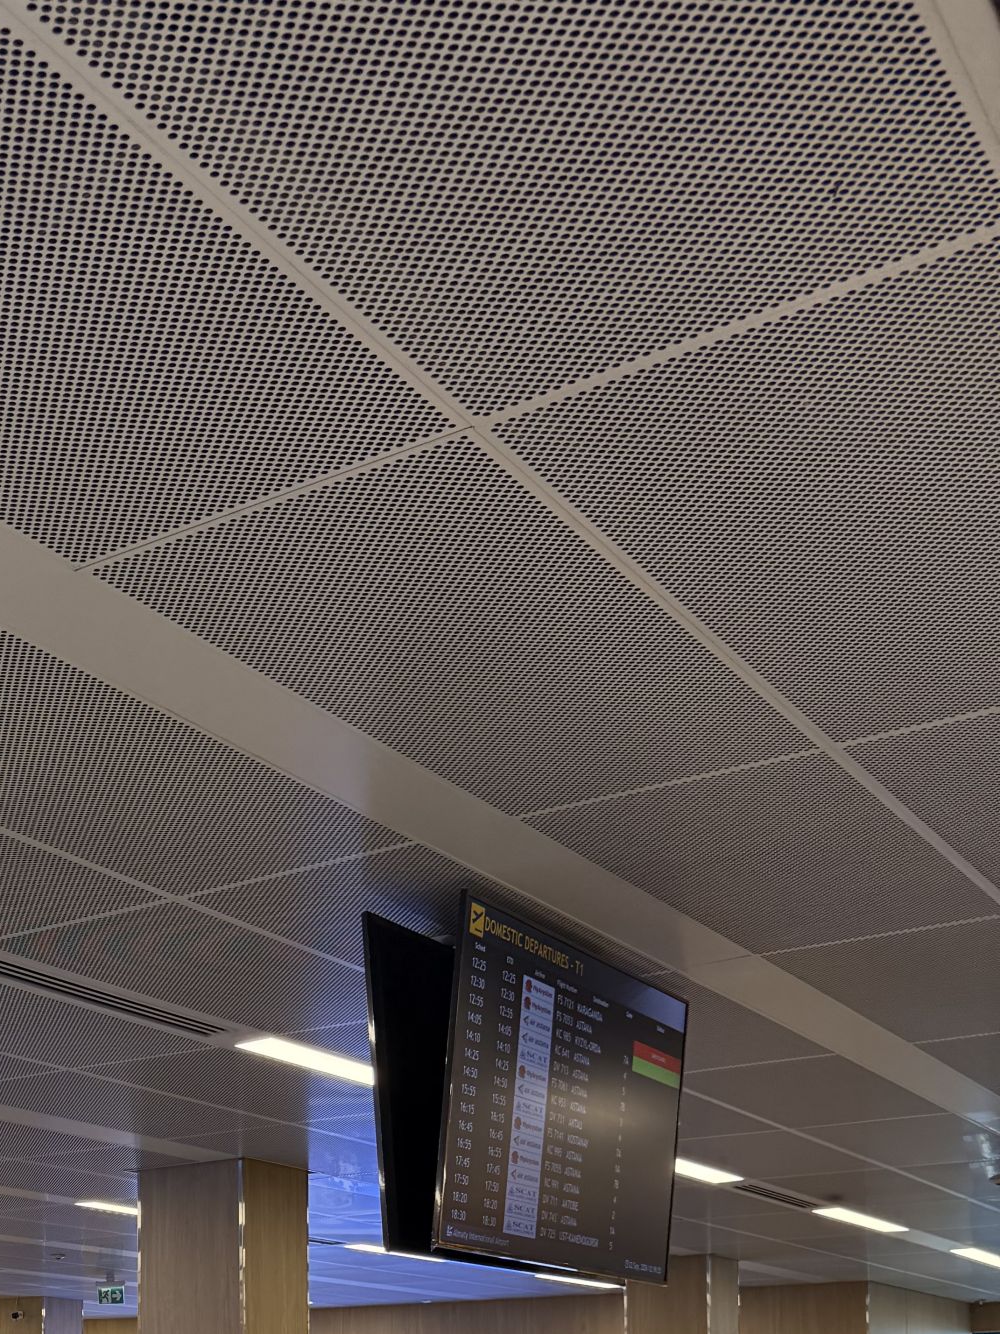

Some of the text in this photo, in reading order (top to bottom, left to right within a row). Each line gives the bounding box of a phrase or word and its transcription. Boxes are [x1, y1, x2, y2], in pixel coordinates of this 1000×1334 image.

[485, 917, 523, 948] DOMESTIC
[524, 935, 569, 969] DEPARTURES
[575, 960, 584, 977] T1
[471, 955, 486, 972] 12:25
[470, 973, 485, 990] 12:30
[501, 968, 516, 985] 12:25
[468, 992, 483, 1008] 12:55
[500, 986, 514, 1002] 12:30
[467, 1010, 482, 1026] 14:05
[499, 1004, 513, 1020] 12:55
[497, 1021, 512, 1037] 14:05
[575, 1018, 592, 1034] ASTANA
[465, 1028, 480, 1044] 14:10
[464, 1046, 479, 1062] 14:25
[496, 1039, 510, 1054] 14:10
[526, 1050, 547, 1063] SCAT
[462, 1064, 477, 1079] 14:50
[494, 1057, 509, 1072] 14:25
[493, 1074, 507, 1089] 14:50
[461, 1082, 476, 1097] 15:55
[491, 1092, 506, 1107] 15:55
[459, 1100, 474, 1115] 16:15
[522, 1102, 543, 1114] SCAT
[490, 1109, 504, 1124] 16:15
[458, 1118, 473, 1133] 16:45
[488, 1127, 503, 1141] 16:45
[456, 1136, 471, 1150] 16:55
[487, 1144, 502, 1159] 16:55
[455, 1154, 470, 1168] 17:45
[486, 1162, 500, 1176] 17:45
[453, 1171, 468, 1186] 17:50
[484, 1179, 499, 1193] 17:50
[452, 1190, 467, 1204] 18:20
[515, 1187, 536, 1197] SCAT
[483, 1197, 497, 1211] 18:20
[514, 1204, 535, 1214] SCAT
[450, 1208, 465, 1222] 18:30
[481, 1214, 496, 1228] 18:30
[512, 1221, 533, 1231] SCAT
